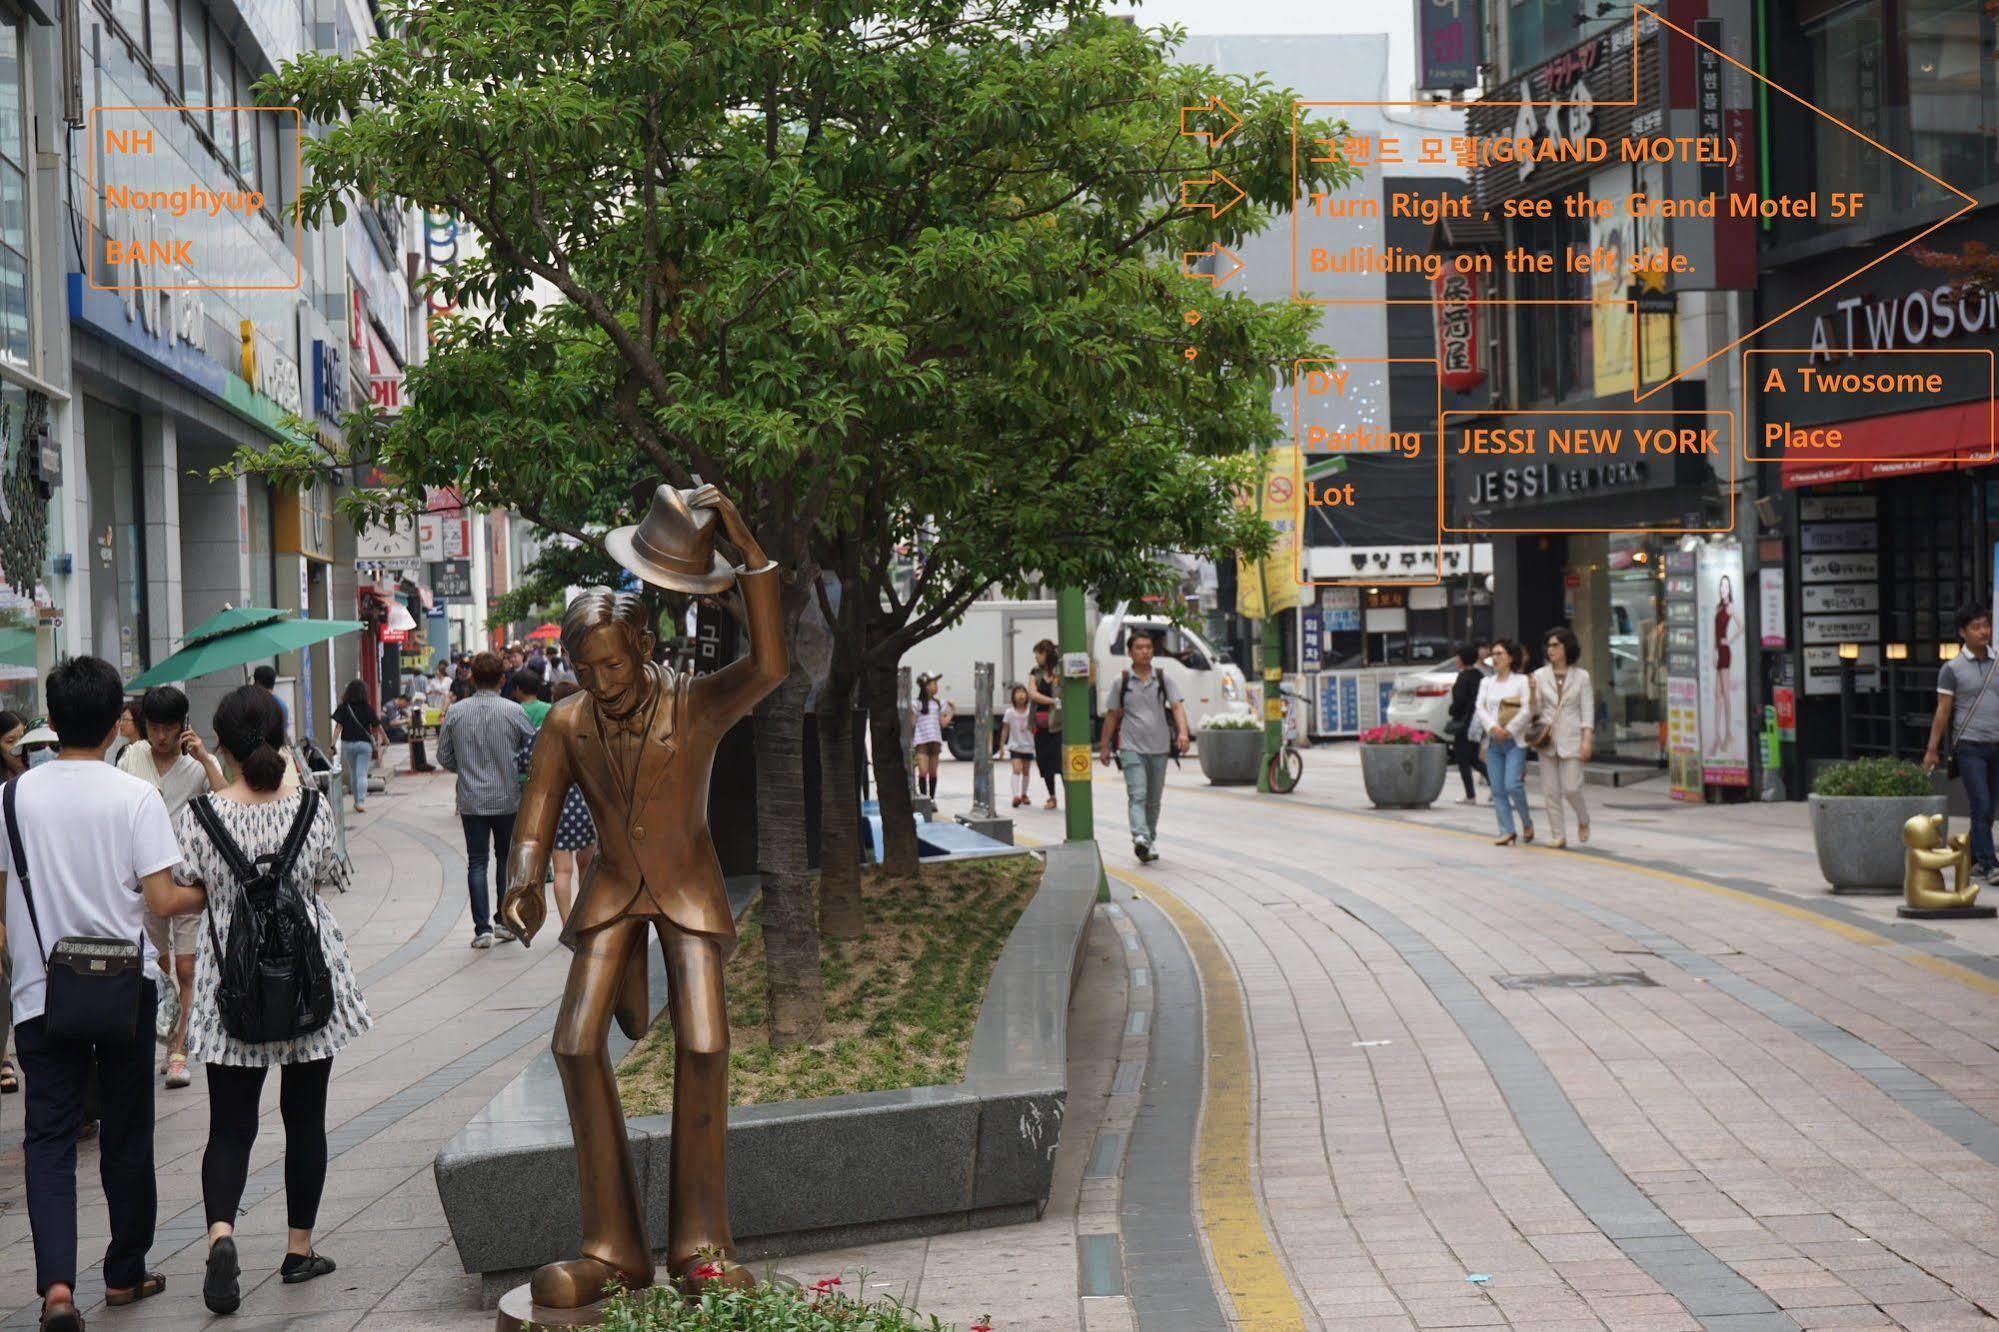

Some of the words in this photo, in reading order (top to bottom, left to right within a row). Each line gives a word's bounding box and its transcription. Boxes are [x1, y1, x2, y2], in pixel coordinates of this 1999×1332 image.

[1469, 463, 1549, 504] JESSI
[1560, 470, 1590, 490] NEW
[1598, 463, 1641, 484] YORK
